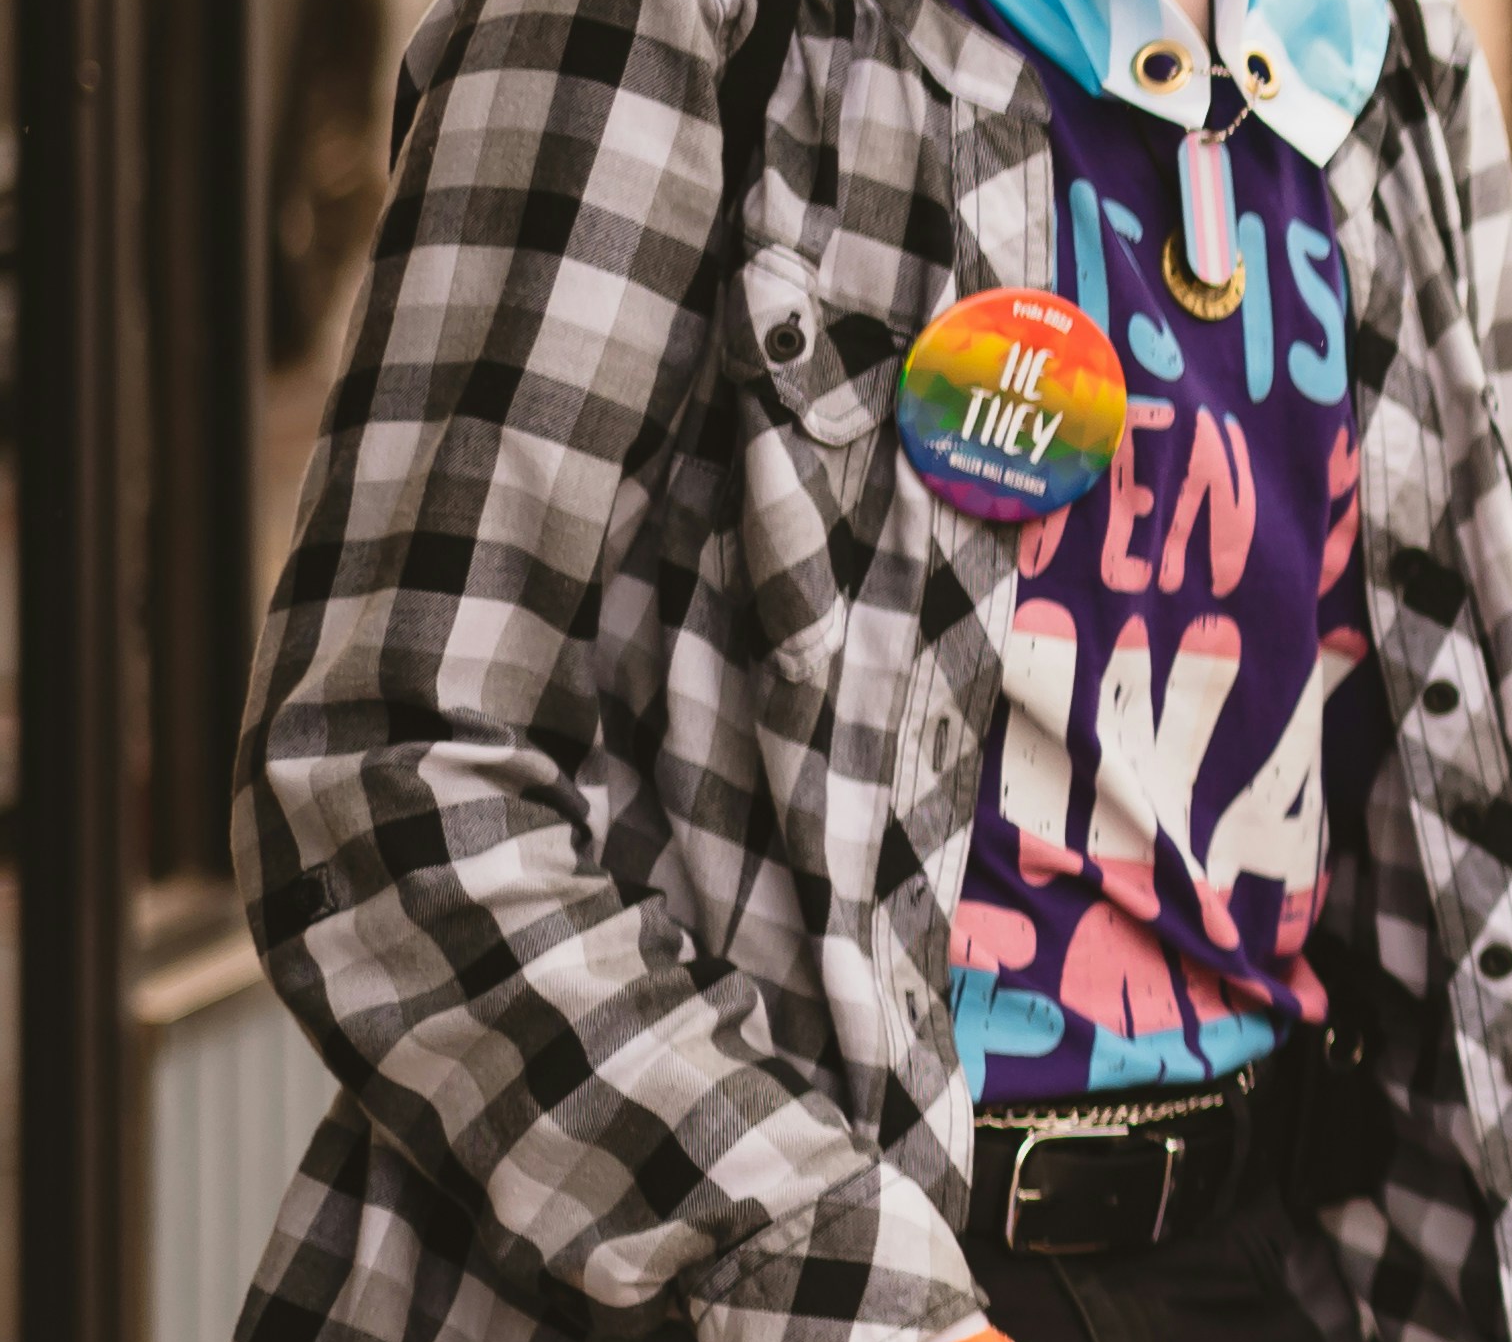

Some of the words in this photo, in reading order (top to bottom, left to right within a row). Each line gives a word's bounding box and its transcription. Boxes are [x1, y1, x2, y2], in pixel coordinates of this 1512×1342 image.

[1012, 299, 1044, 321] Pride
[999, 340, 1055, 401] HE
[960, 386, 1064, 466] THEY
